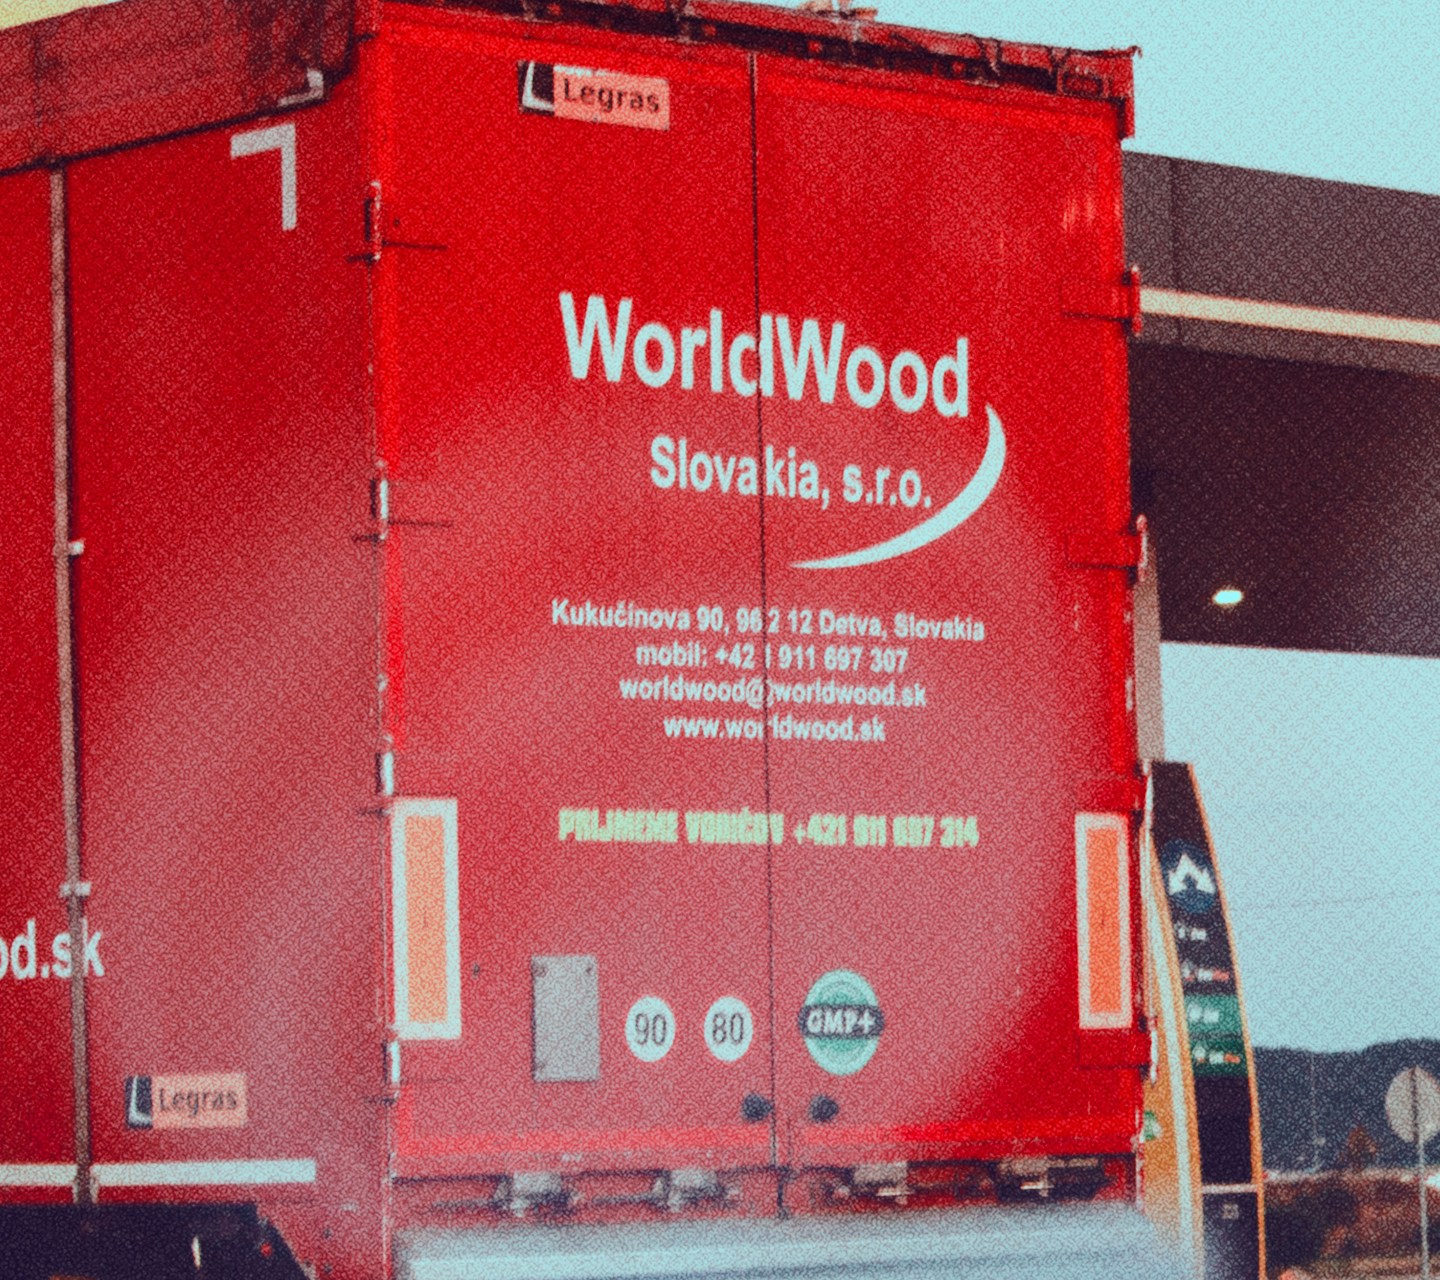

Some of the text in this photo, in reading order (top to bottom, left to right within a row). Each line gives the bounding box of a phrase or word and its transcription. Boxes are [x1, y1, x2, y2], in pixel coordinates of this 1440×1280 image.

[564, 78, 660, 114] Legras
[560, 291, 969, 419] WorldWood
[650, 433, 932, 510] Slovakia, s.r.o.
[696, 605, 729, 636] 90,
[787, 608, 813, 635] 12
[819, 608, 888, 641] Detva,
[894, 612, 985, 642] Slovakia
[636, 640, 708, 667] mobil:
[779, 644, 815, 670] 911
[870, 647, 908, 673] 307
[619, 674, 927, 709] worldwood@worldwood.sk
[663, 713, 886, 742] www.worldwood.sk
[633, 1012, 668, 1046] 90
[711, 1012, 745, 1045] 80
[806, 1008, 876, 1036] GMP+
[159, 1086, 239, 1116] Legras
